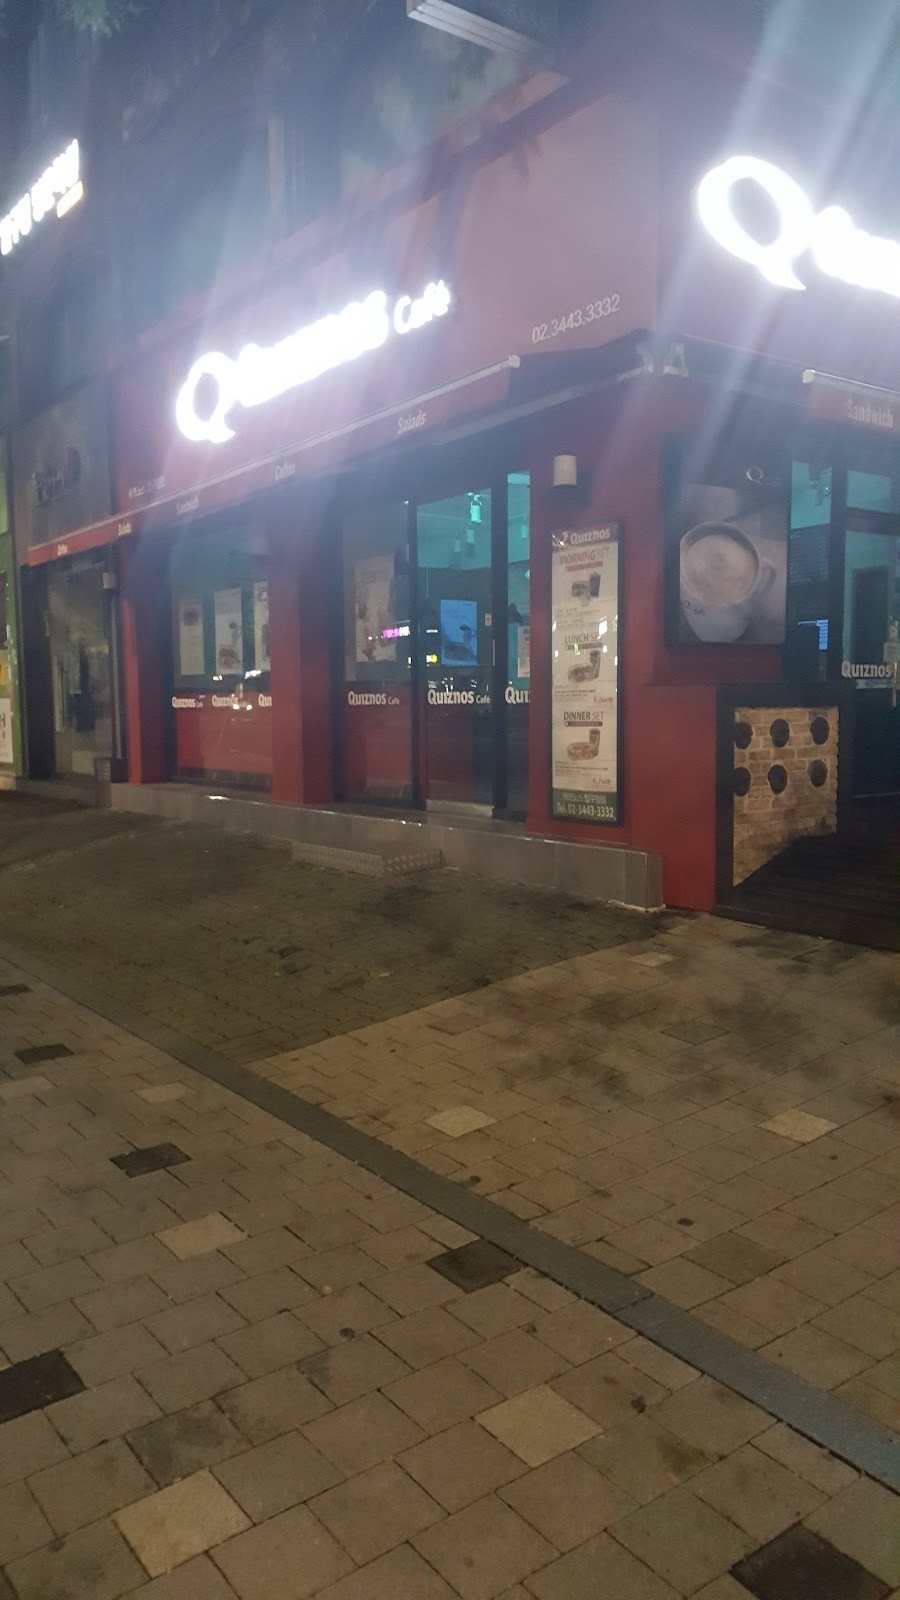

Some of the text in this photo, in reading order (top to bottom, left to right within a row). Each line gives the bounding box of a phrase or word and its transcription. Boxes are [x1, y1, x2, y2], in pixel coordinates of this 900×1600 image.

[532, 294, 621, 343] 02.3443.3332
[397, 410, 427, 434] Salads
[570, 528, 611, 545] Quiznos
[564, 633, 589, 643] LUNCH
[842, 660, 892, 678] Quiznos
[348, 691, 387, 706] Quiznos
[427, 690, 474, 705] Quiznos
[564, 711, 604, 721] DINNER SET
